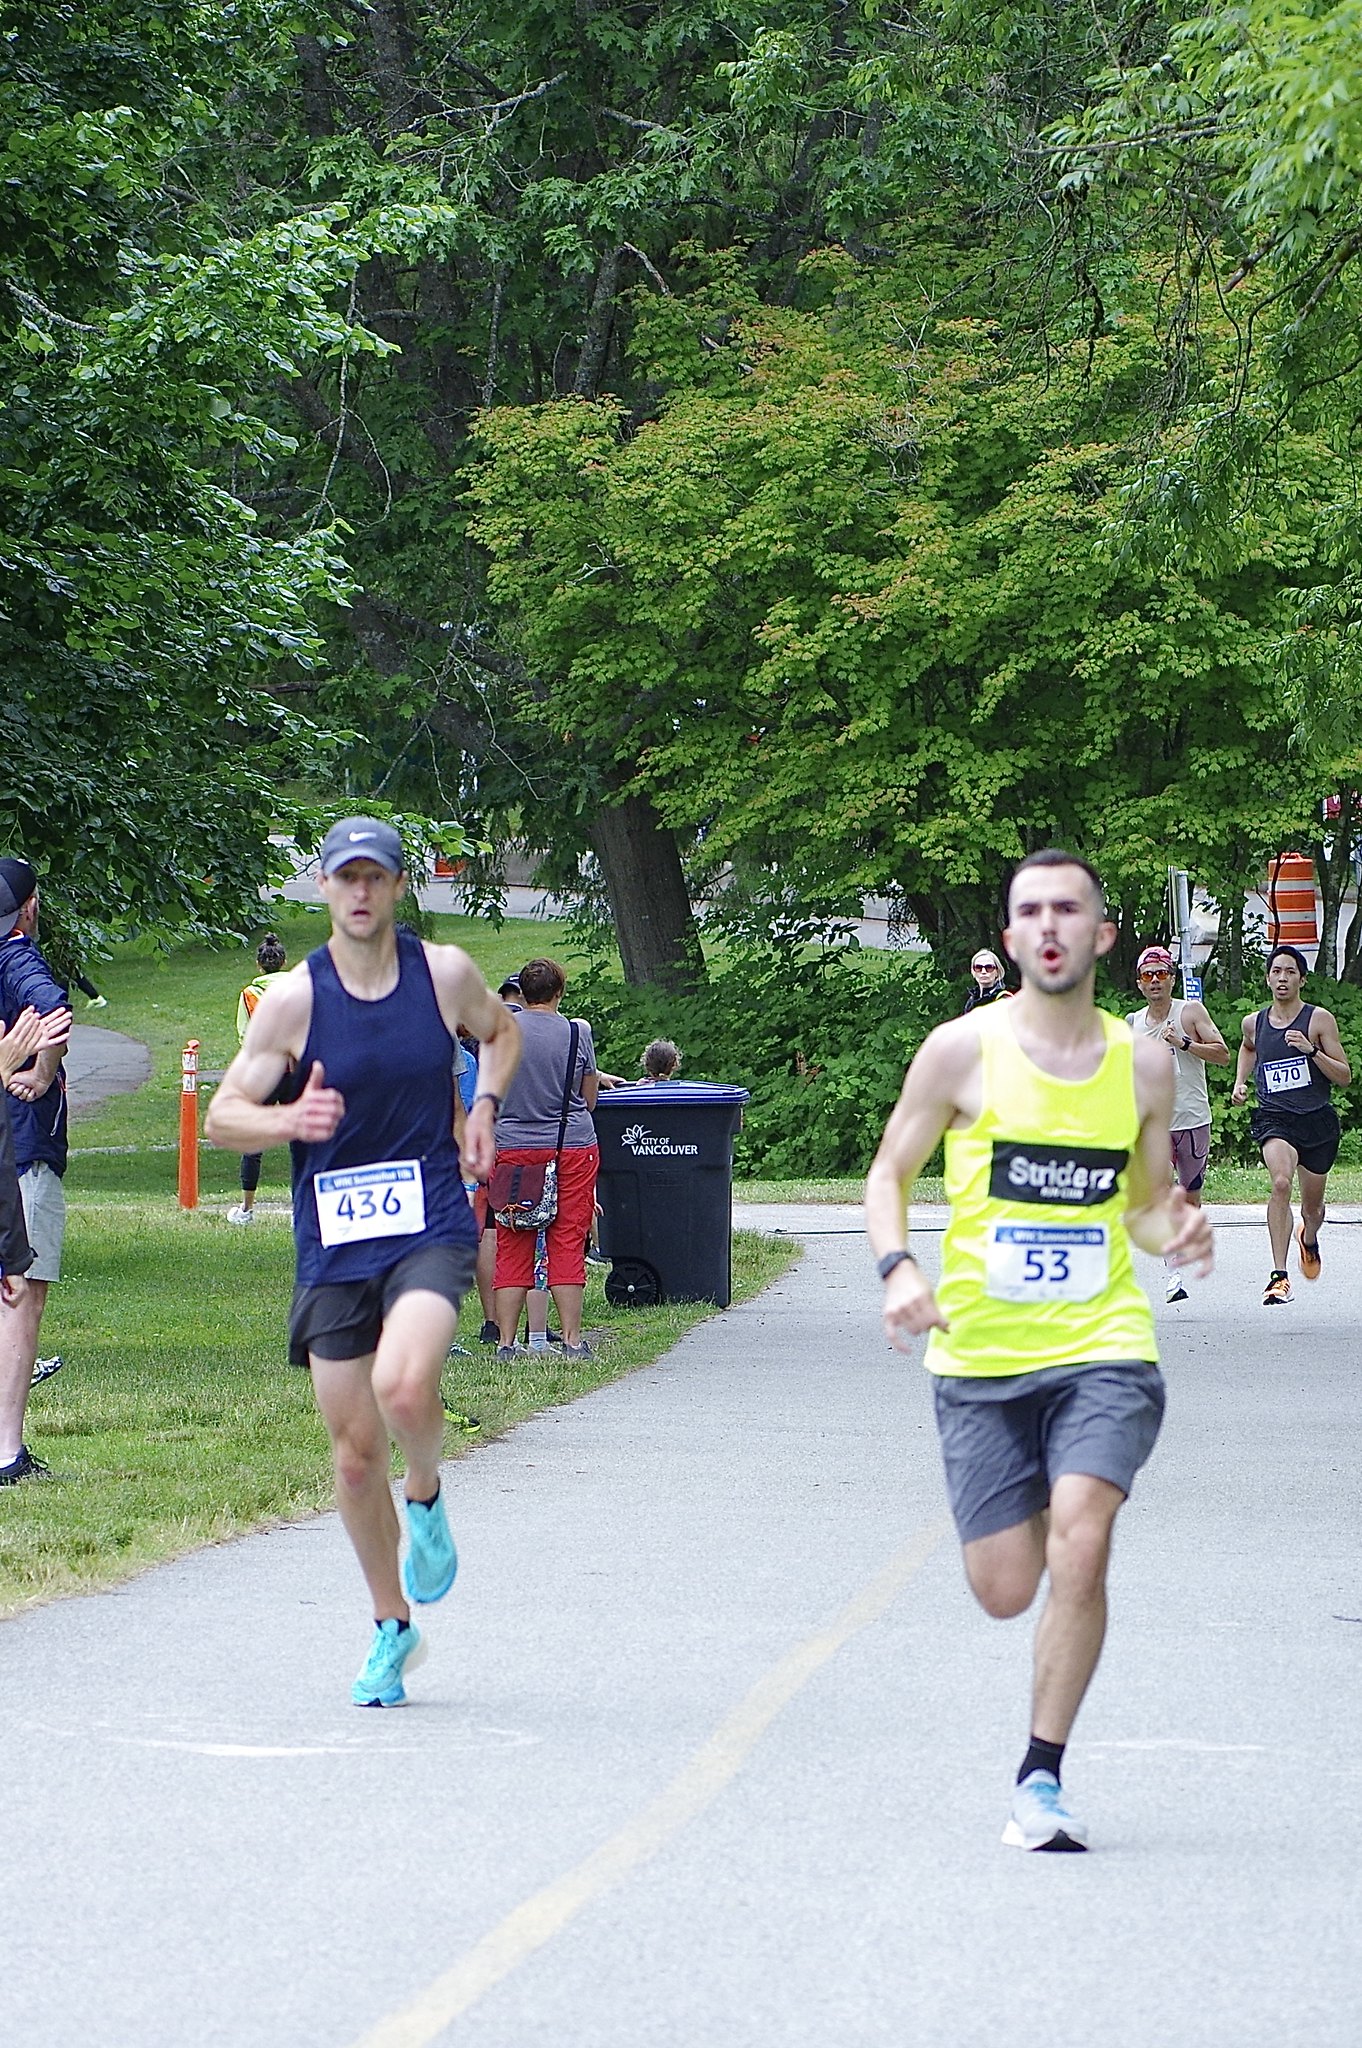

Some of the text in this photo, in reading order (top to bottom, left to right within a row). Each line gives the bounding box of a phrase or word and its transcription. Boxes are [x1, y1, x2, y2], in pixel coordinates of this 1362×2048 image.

[1272, 1067, 1301, 1084] 470
[631, 1145, 699, 1156] VANCOUVER
[641, 1137, 670, 1145] CITY OF
[1008, 1156, 1116, 1190] Striderz
[337, 1187, 402, 1222] 436
[1023, 1249, 1070, 1282] 53
